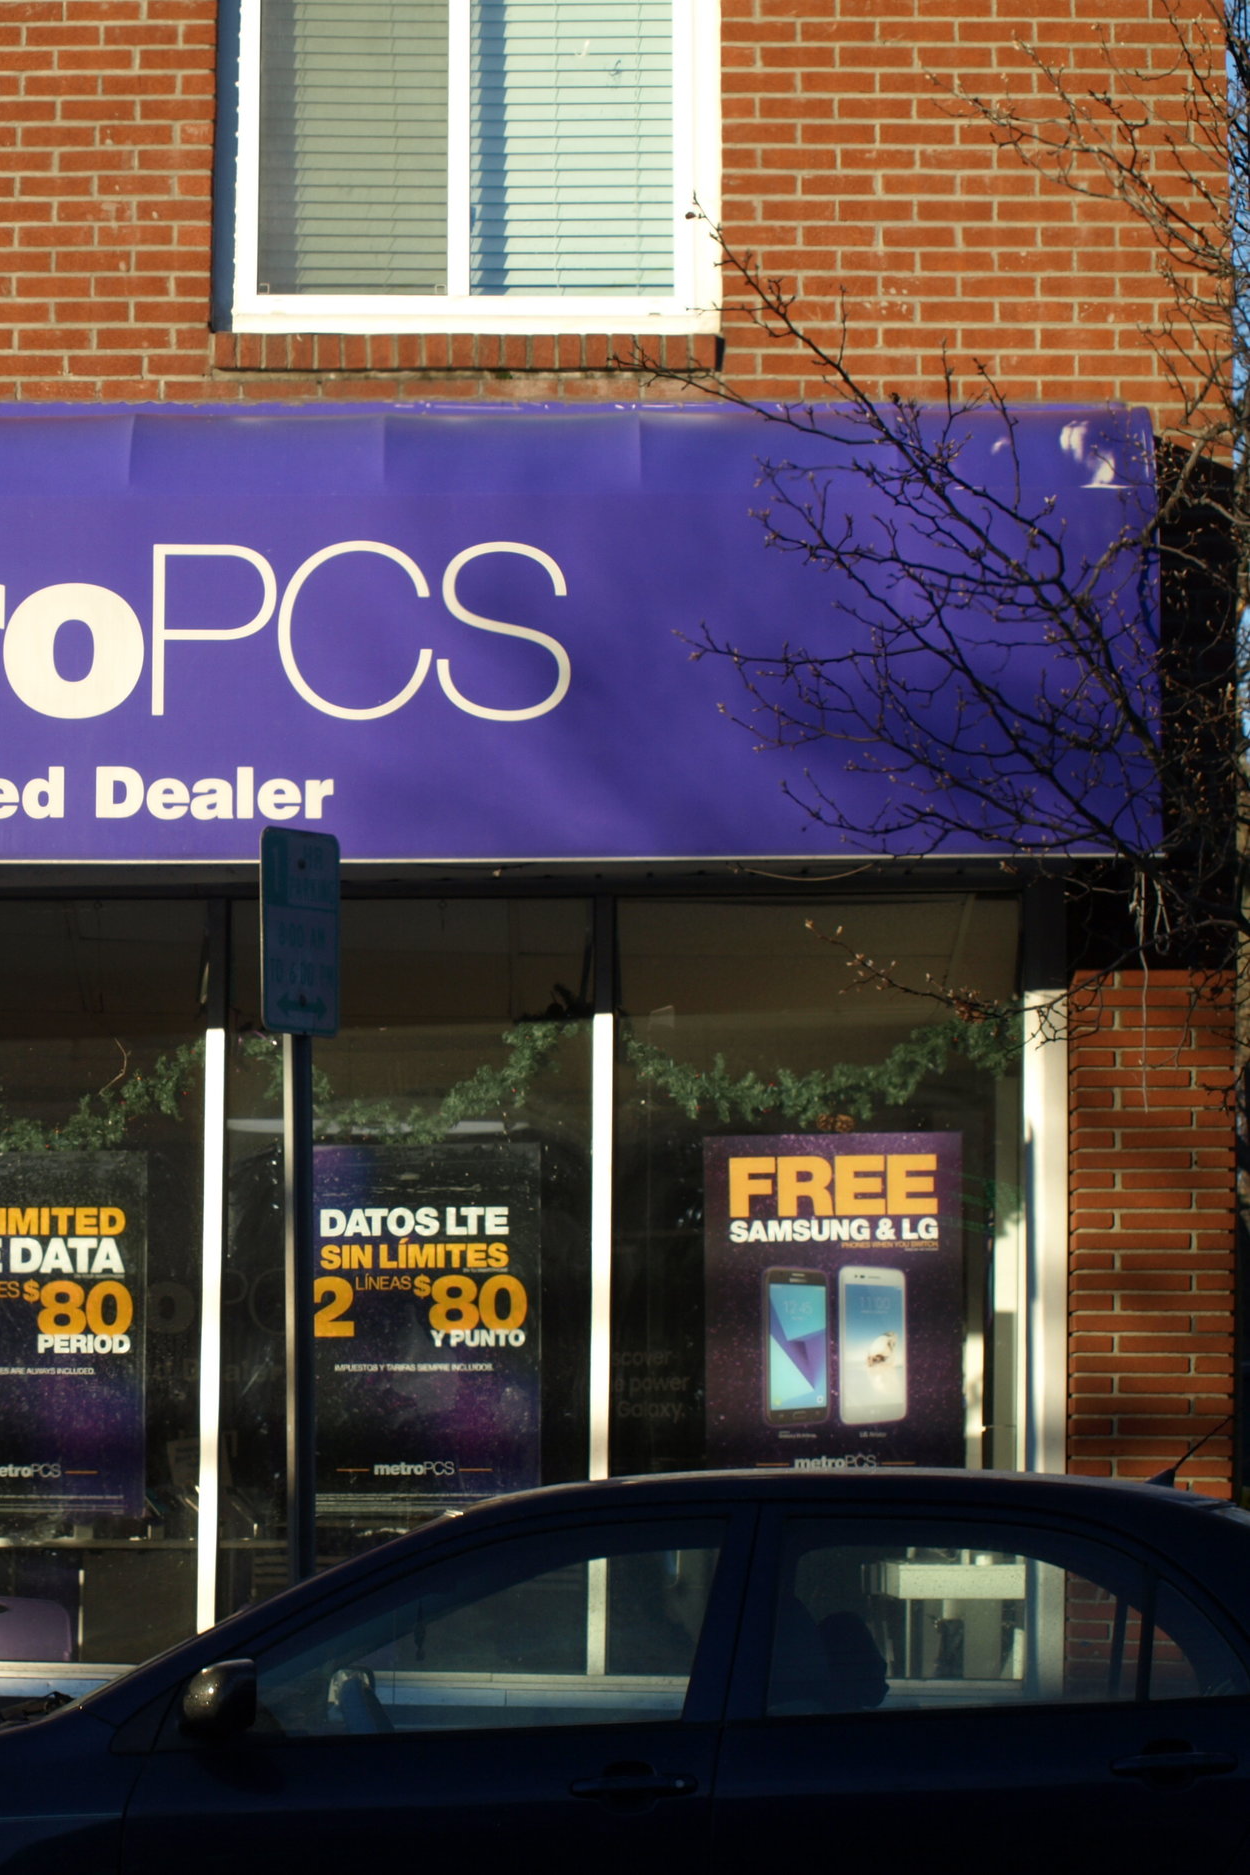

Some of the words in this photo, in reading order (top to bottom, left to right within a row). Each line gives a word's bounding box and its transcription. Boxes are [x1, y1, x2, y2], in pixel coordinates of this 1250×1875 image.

[94, 765, 335, 821] Dealer
[728, 1153, 939, 1218] FREE
[319, 1207, 441, 1237] DATOS
[446, 1206, 510, 1236] LTE
[729, 1218, 871, 1243] SAMSUNG
[875, 1217, 897, 1240] &
[901, 1217, 939, 1240] LG
[9, 1237, 126, 1274] DATA
[320, 1243, 373, 1270] SIN
[379, 1238, 510, 1269] LÍMITES
[22, 1278, 134, 1336] $80
[313, 1275, 354, 1337] 2
[355, 1273, 412, 1291] LÍNEAS
[413, 1273, 528, 1334] $80
[37, 1334, 131, 1354] PERIOD
[430, 1329, 445, 1347] Y
[449, 1329, 526, 1348] PUNTO
[373, 1461, 455, 1476] metroPCS
[794, 1455, 877, 1470] metroPCS
